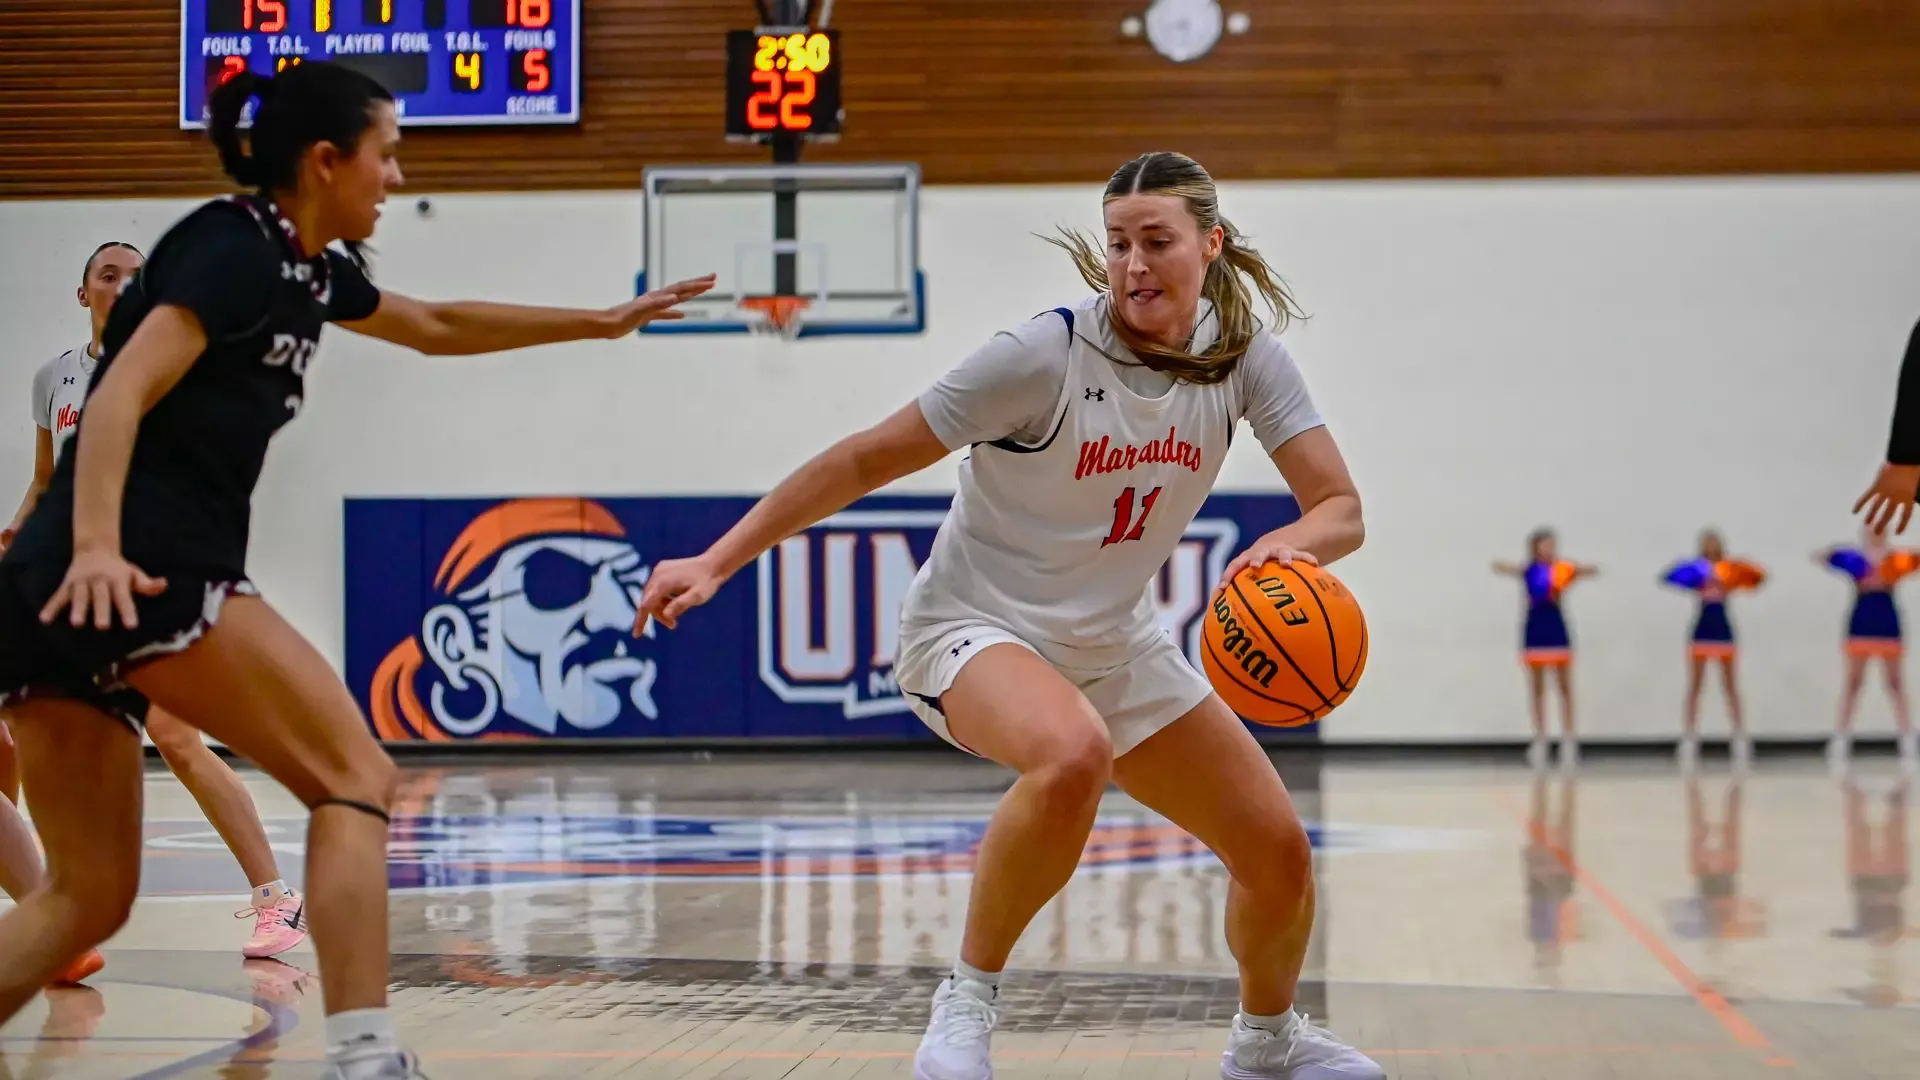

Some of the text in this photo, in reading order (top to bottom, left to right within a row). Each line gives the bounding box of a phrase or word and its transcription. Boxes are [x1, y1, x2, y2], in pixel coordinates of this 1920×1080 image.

[202, 36, 252, 56] FOULS
[266, 35, 310, 56] T.O.L.
[325, 31, 432, 54] PLAYER FOUL
[444, 30, 489, 52] T.O.L.
[504, 29, 556, 51] FOULS
[754, 33, 831, 72] 2:50
[455, 53, 480, 91] 4
[523, 48, 549, 92] 5
[747, 69, 816, 130] 22
[1100, 486, 1163, 550] 11
[1213, 588, 1279, 689] Wilson
